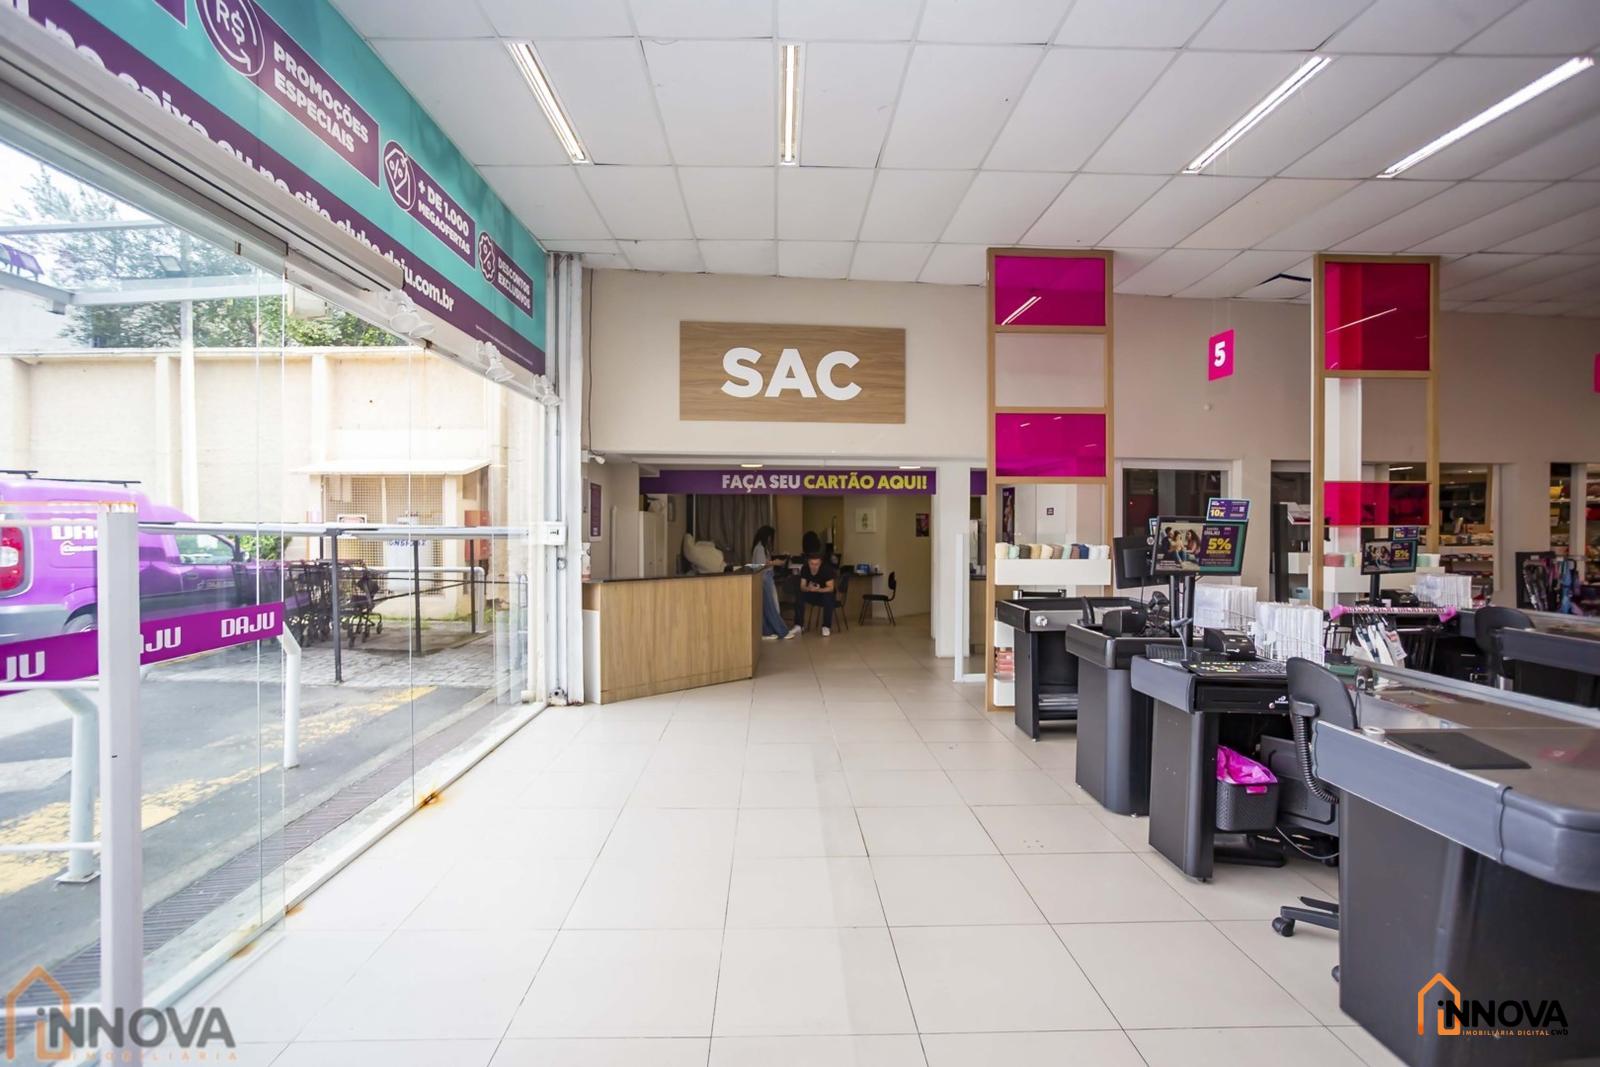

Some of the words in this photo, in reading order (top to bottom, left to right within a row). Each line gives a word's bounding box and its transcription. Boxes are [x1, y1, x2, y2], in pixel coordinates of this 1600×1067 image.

[273, 40, 369, 144] PROMOÇÕES
[273, 67, 355, 153] ESPECIAIS
[418, 199, 471, 256] MEGAOFERTAS
[427, 185, 444, 213] DE
[443, 199, 470, 238] 1.000
[497, 271, 532, 310] EXCLUSIVOS
[720, 346, 863, 401] SAC
[1213, 339, 1227, 368] 5
[721, 474, 767, 493] FAÇA
[769, 475, 801, 489] SEU
[803, 472, 875, 490] CARTÃO
[877, 475, 928, 490] AQUI!
[1207, 537, 1233, 551] 5%
[220, 611, 275, 638] DAJU
